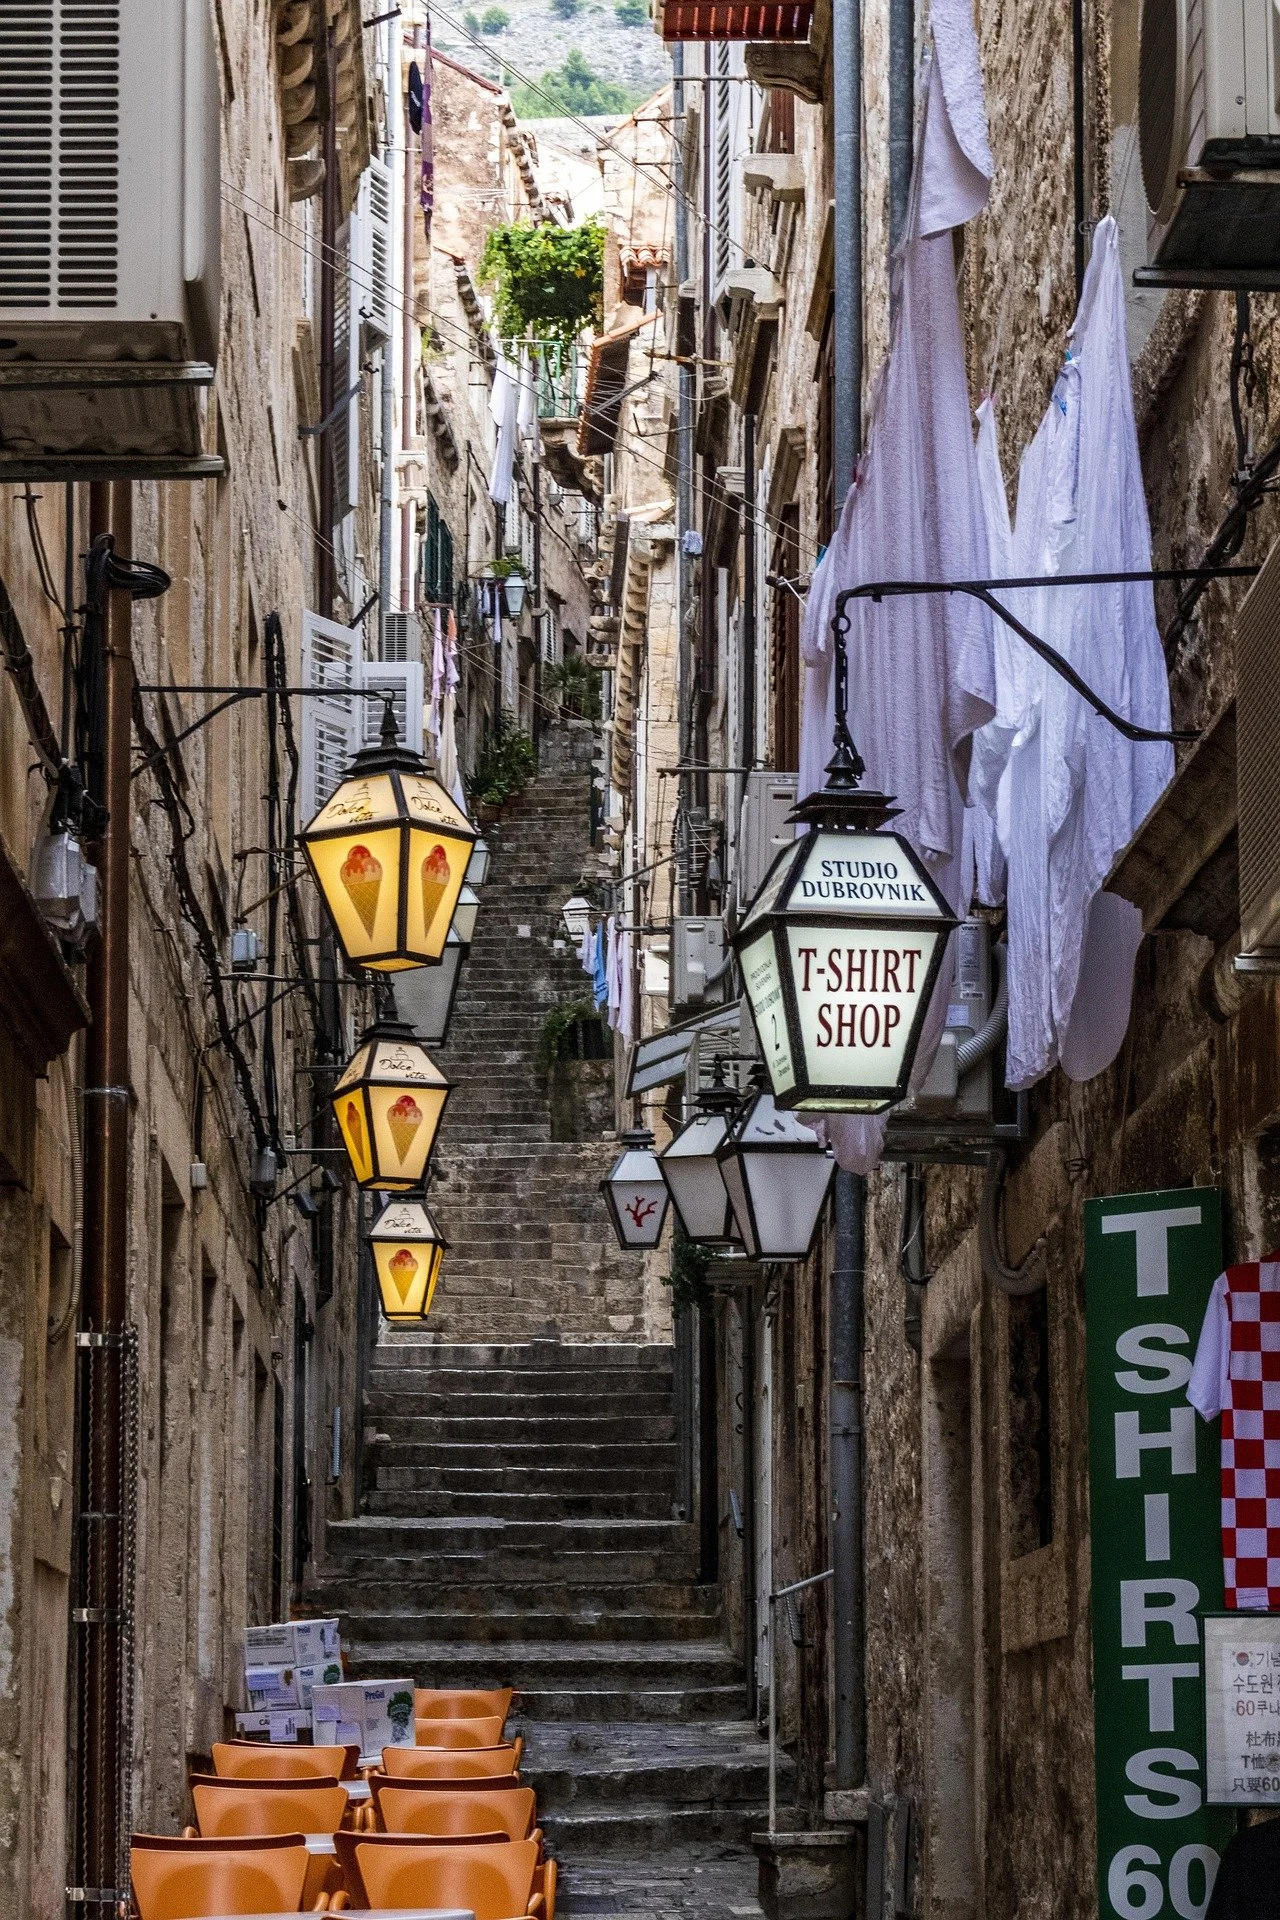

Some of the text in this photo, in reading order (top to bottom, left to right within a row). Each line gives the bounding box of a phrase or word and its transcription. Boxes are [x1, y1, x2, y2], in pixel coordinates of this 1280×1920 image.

[821, 860, 898, 880] STUDIO
[801, 880, 926, 901] DUBROVNIK
[798, 948, 922, 993] T-SHIRT
[816, 1003, 901, 1048] SHOP
[1233, 1673, 1273, 1694] 수도원
[1246, 1730, 1280, 1748] 杜布
[1108, 1843, 1221, 1920] 60
